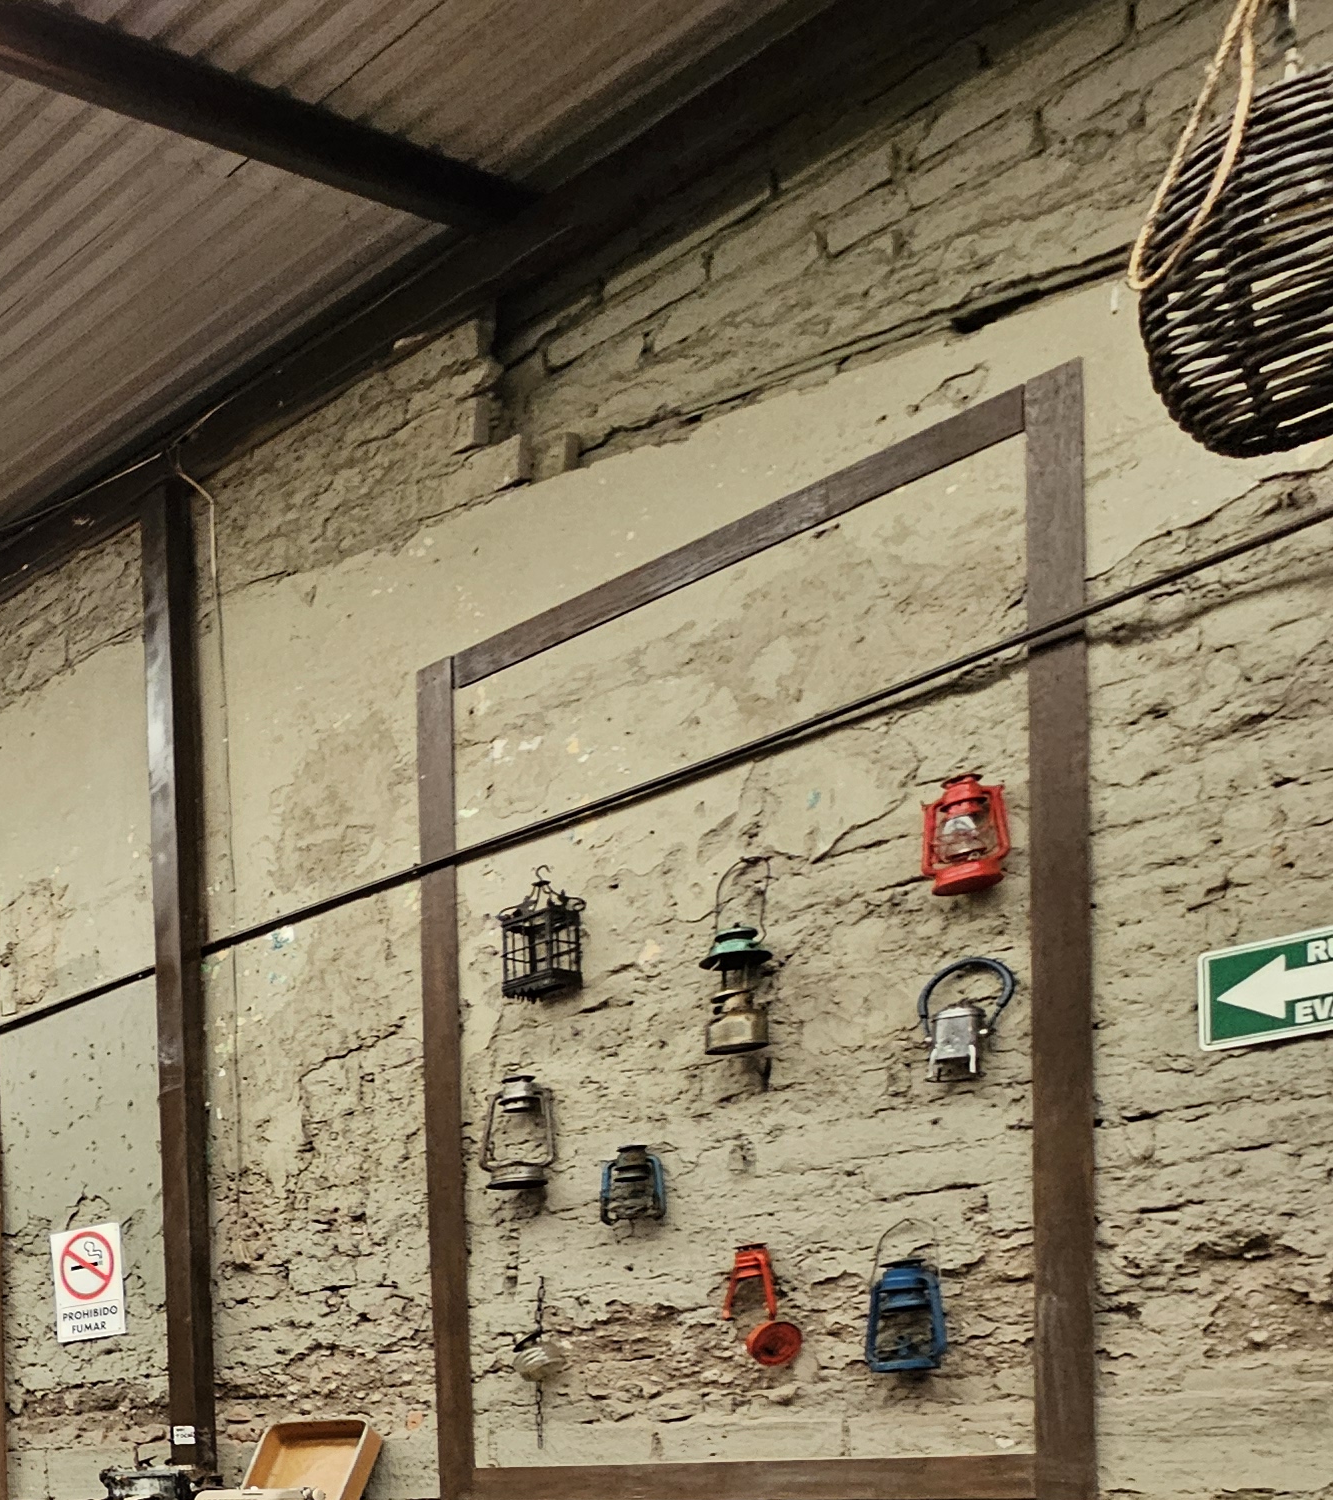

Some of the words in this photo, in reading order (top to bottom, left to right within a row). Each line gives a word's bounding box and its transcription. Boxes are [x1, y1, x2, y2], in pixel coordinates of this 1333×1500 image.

[1307, 938, 1333, 963] R
[1295, 996, 1333, 1023] EV
[62, 1305, 118, 1321] PROHIBIDO
[72, 1321, 106, 1334] FUMAR
